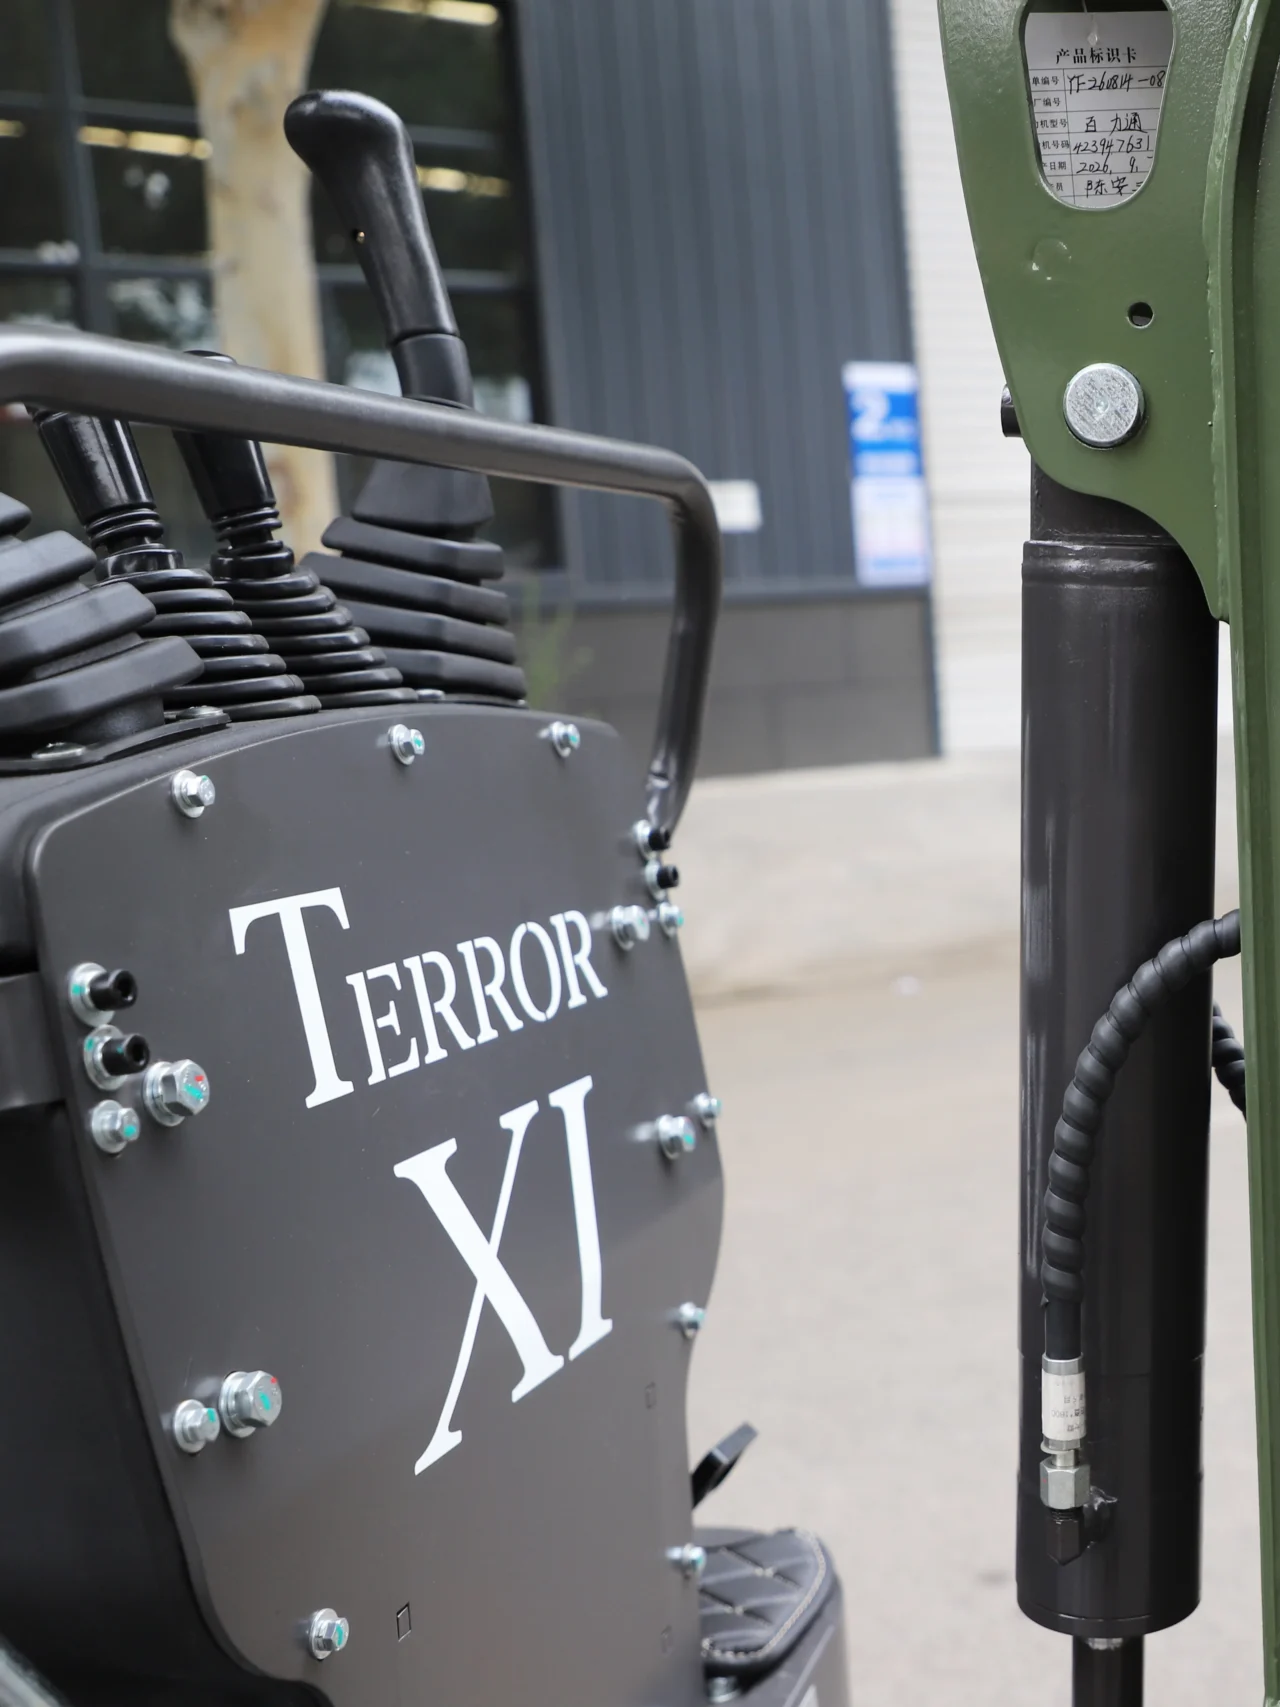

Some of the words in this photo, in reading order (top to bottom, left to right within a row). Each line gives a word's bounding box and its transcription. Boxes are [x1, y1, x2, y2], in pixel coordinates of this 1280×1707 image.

[1056, 47, 1137, 64] 产品标识卡
[1036, 118, 1067, 129] 机型号
[1040, 140, 1070, 150] 机号码
[228, 886, 608, 1110] TERROR
[393, 1075, 613, 1476] XI
